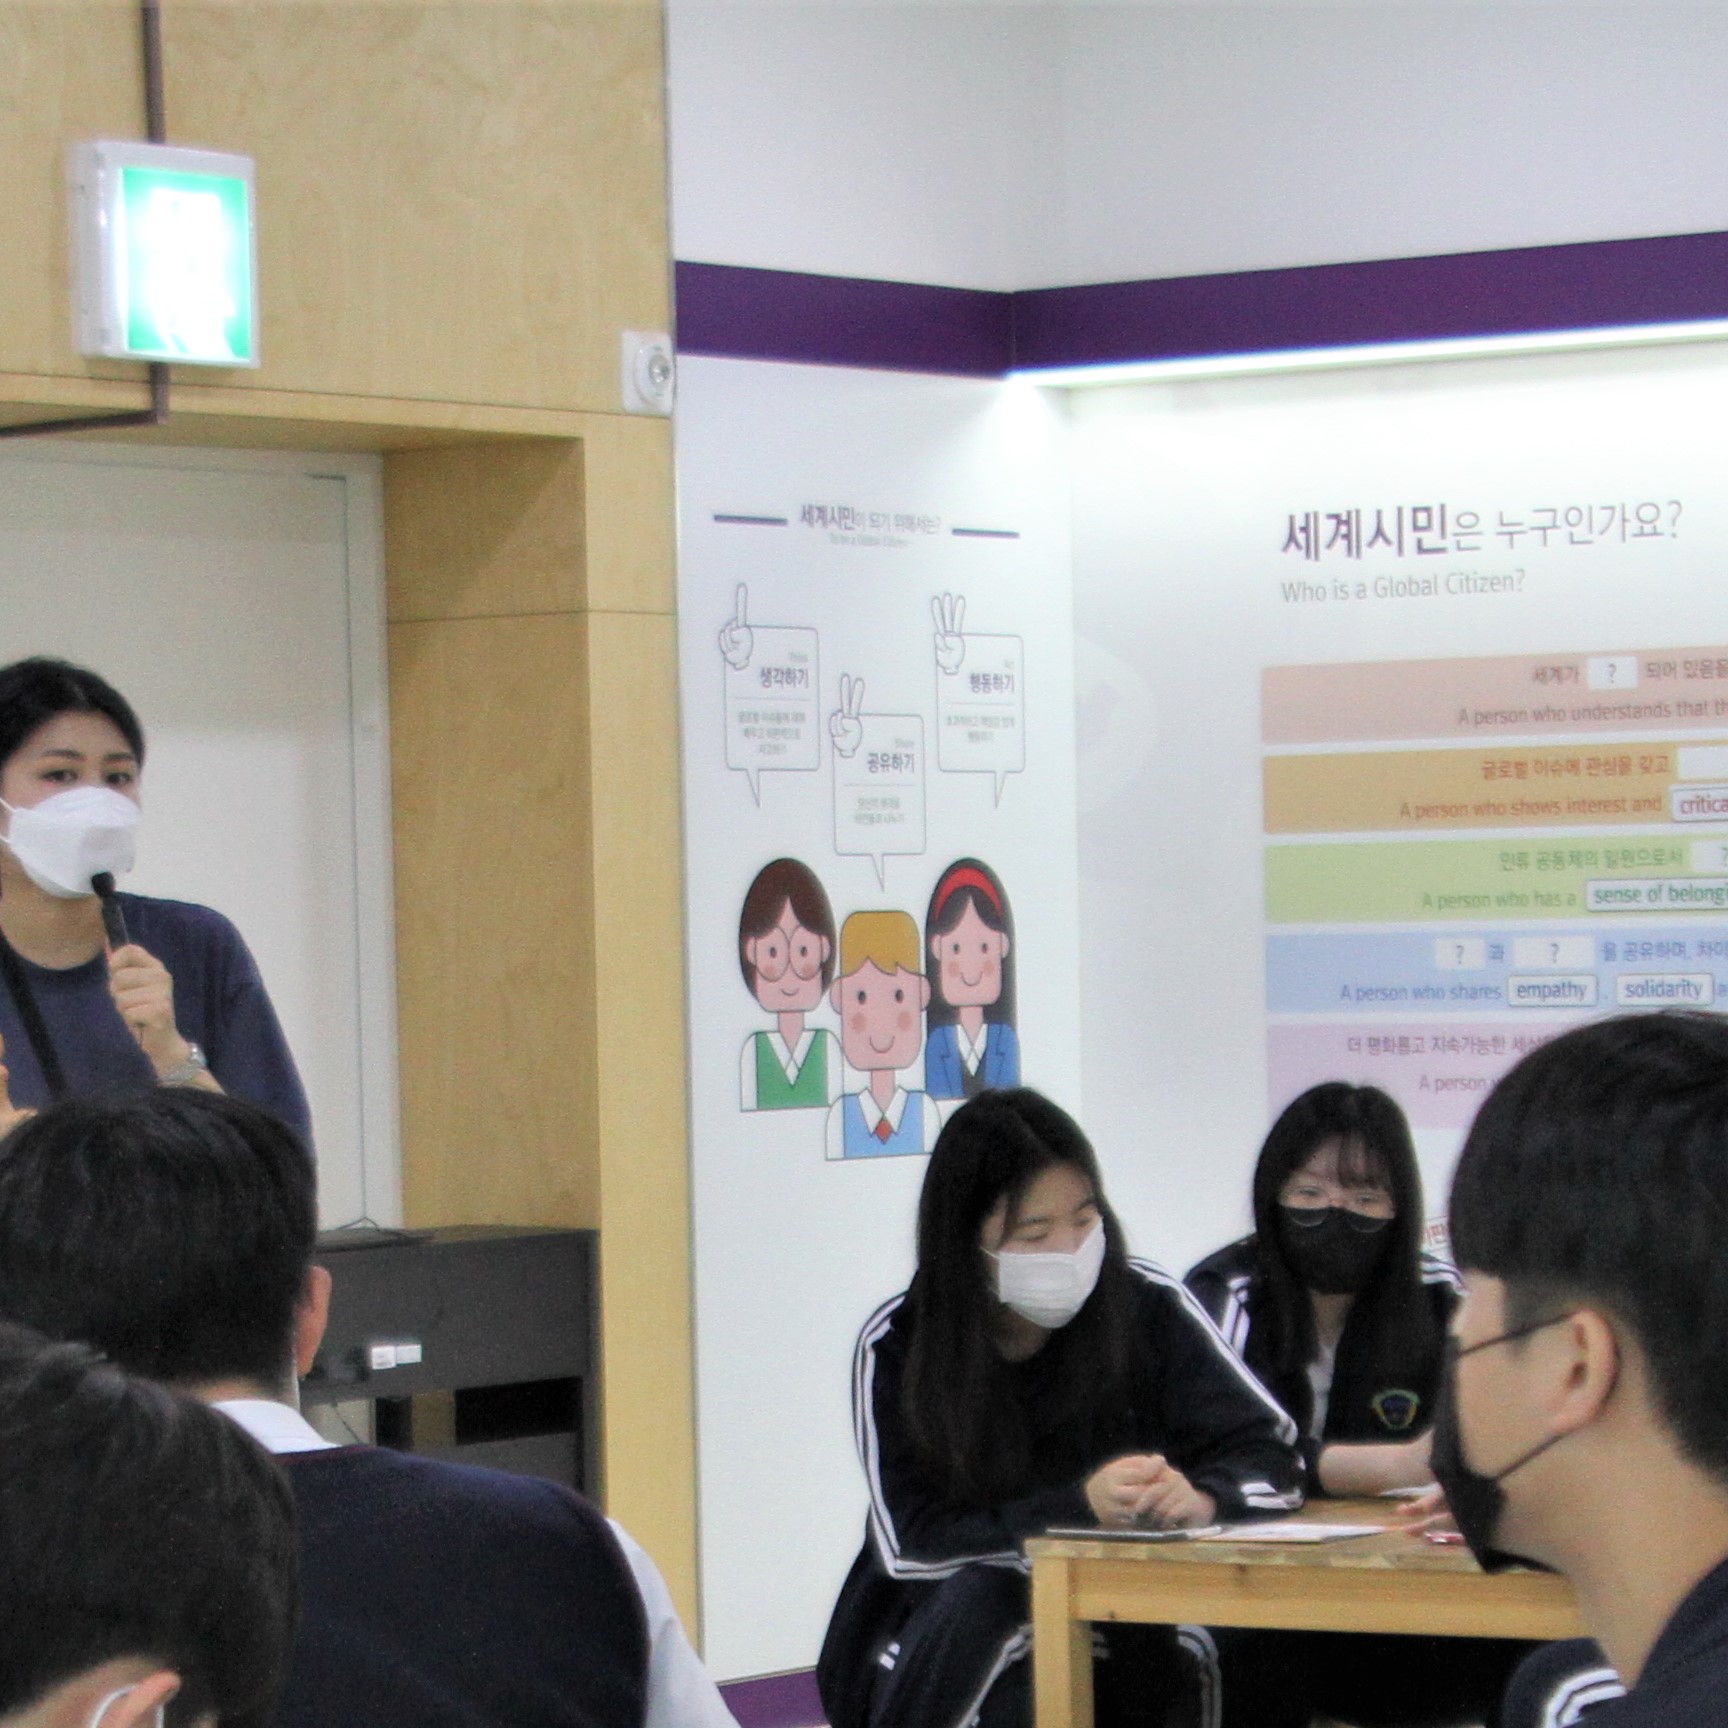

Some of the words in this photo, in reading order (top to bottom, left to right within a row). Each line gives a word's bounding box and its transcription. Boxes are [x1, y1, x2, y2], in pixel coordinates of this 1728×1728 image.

[1280, 502, 1484, 562] 세계시민은
[1495, 499, 1684, 551] 누구인가요?
[1281, 579, 1327, 604] Who
[1332, 578, 1351, 602] is
[1355, 582, 1368, 600] a
[1374, 573, 1440, 600] Global
[1445, 567, 1527, 597] Citizen?
[760, 667, 809, 689] 생각하기
[1458, 709, 1470, 725] A
[1473, 707, 1529, 728] person
[1532, 704, 1567, 723] who
[1571, 699, 1672, 721] understands
[1676, 698, 1710, 718] that
[867, 752, 915, 774] 공유하기
[1414, 803, 1470, 820] person
[1474, 800, 1507, 818] who
[1510, 798, 1561, 816] shows
[1567, 796, 1628, 815] interest
[1632, 796, 1663, 812] and
[1437, 892, 1490, 910] person
[1494, 890, 1532, 908] who
[1533, 889, 1561, 908] has
[1594, 888, 1643, 905] sense
[1646, 884, 1663, 903] of
[1355, 984, 1409, 1003] person
[1412, 983, 1447, 1000] who
[1449, 981, 1503, 1000] shares
[1516, 981, 1588, 1004] empathy
[1624, 978, 1704, 1002] solidarity
[1433, 1076, 1486, 1094] person
